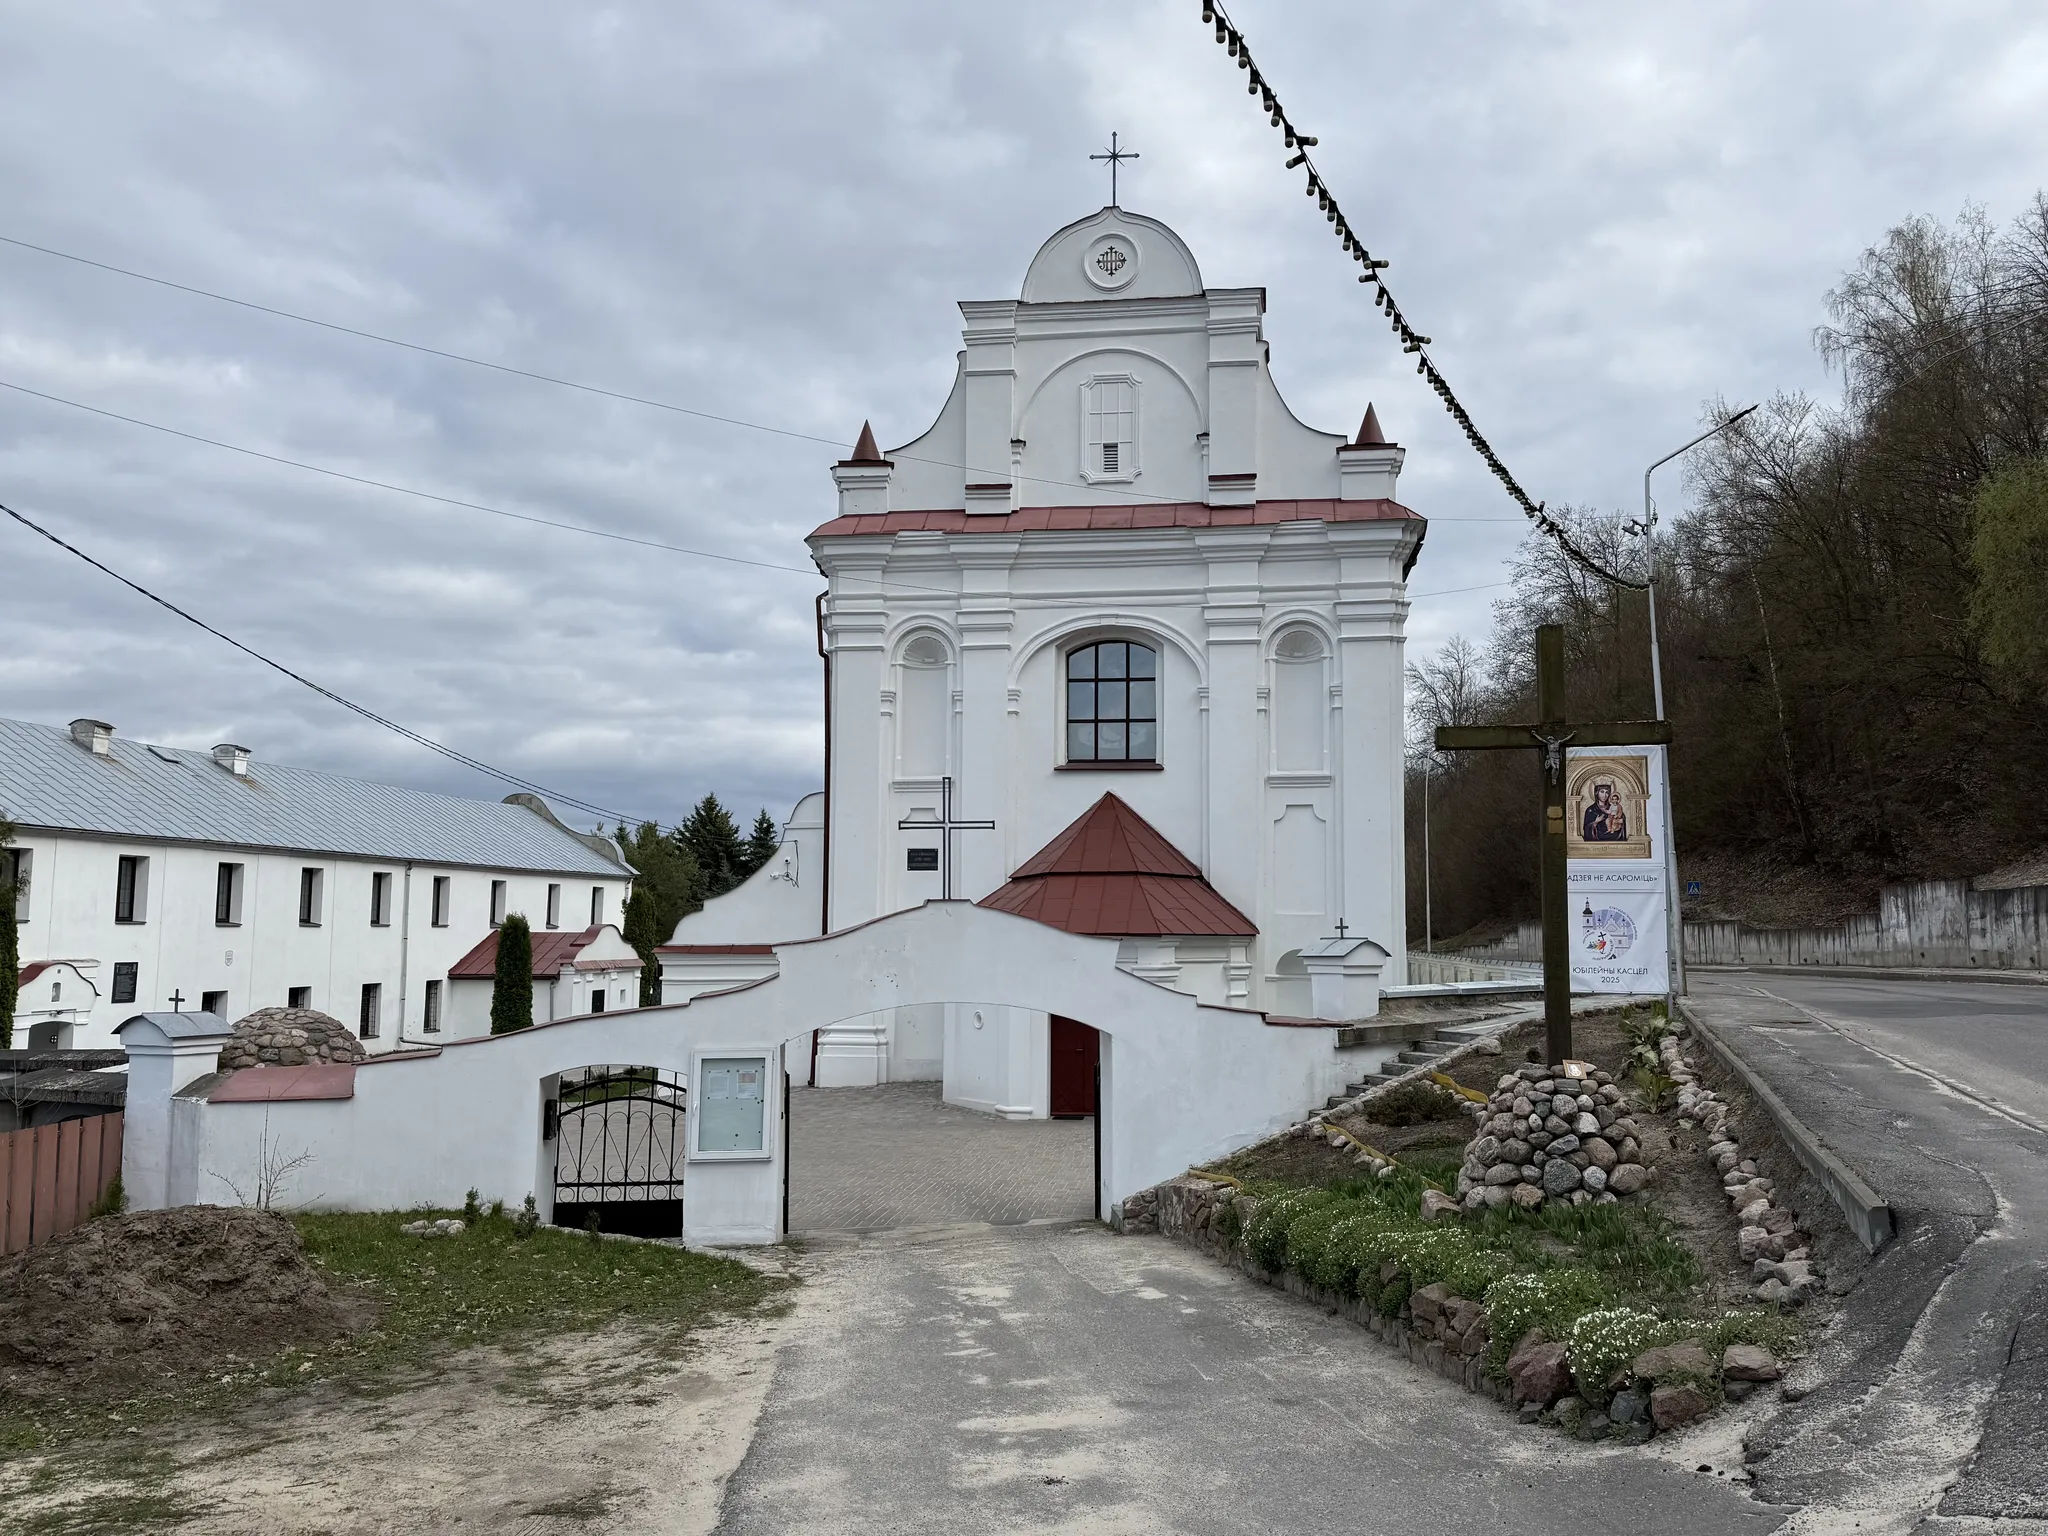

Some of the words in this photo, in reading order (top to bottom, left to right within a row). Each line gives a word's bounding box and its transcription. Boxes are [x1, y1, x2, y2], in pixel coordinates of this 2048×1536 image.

[1567, 874, 1592, 882] АДЗЕЯ
[1593, 874, 1604, 882] НЕ
[1572, 966, 1615, 974] ЮБІЛЕЙНЫ
[1601, 976, 1620, 984] 2025
